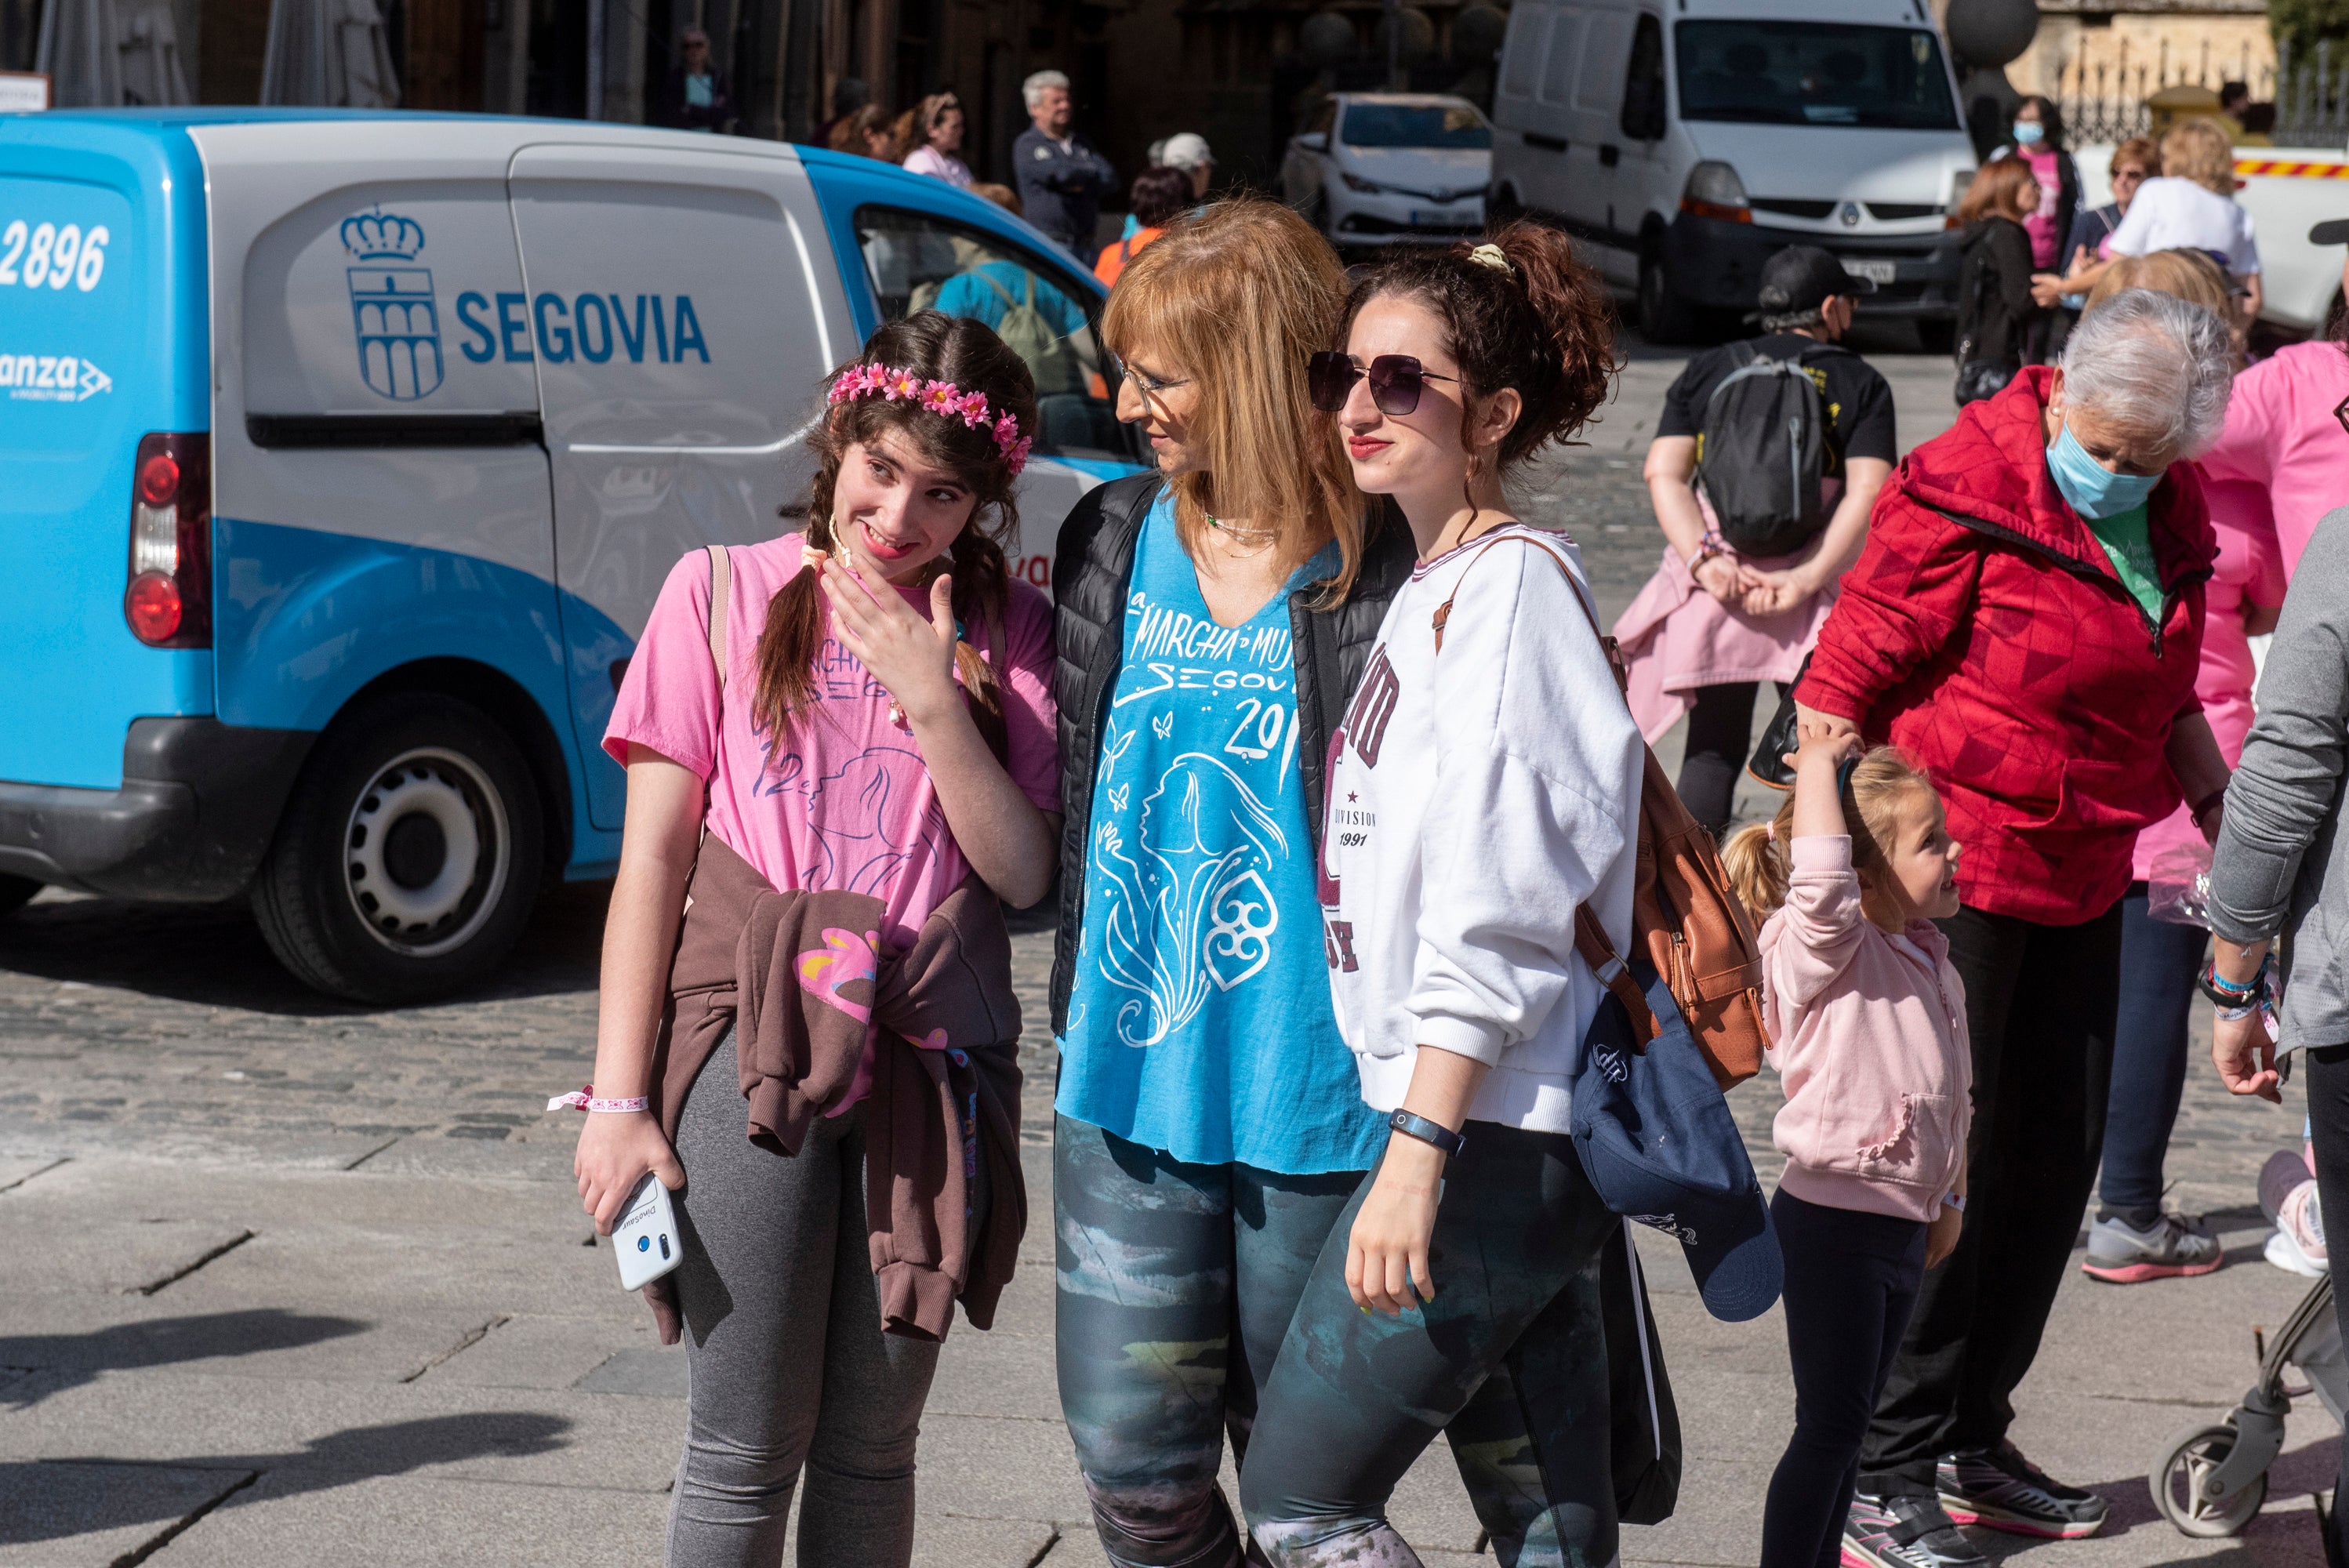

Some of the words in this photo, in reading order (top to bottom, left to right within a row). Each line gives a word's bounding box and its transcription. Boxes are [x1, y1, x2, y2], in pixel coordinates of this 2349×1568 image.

[0, 219, 109, 292] 2896
[456, 290, 710, 364] SEGOVIA
[1129, 605, 1240, 662] MARCHA
[1249, 626, 1294, 672] MUJ
[1113, 665, 1297, 708] SEGOV
[1225, 696, 1302, 795] 201
[1340, 833, 1368, 847] 1991
